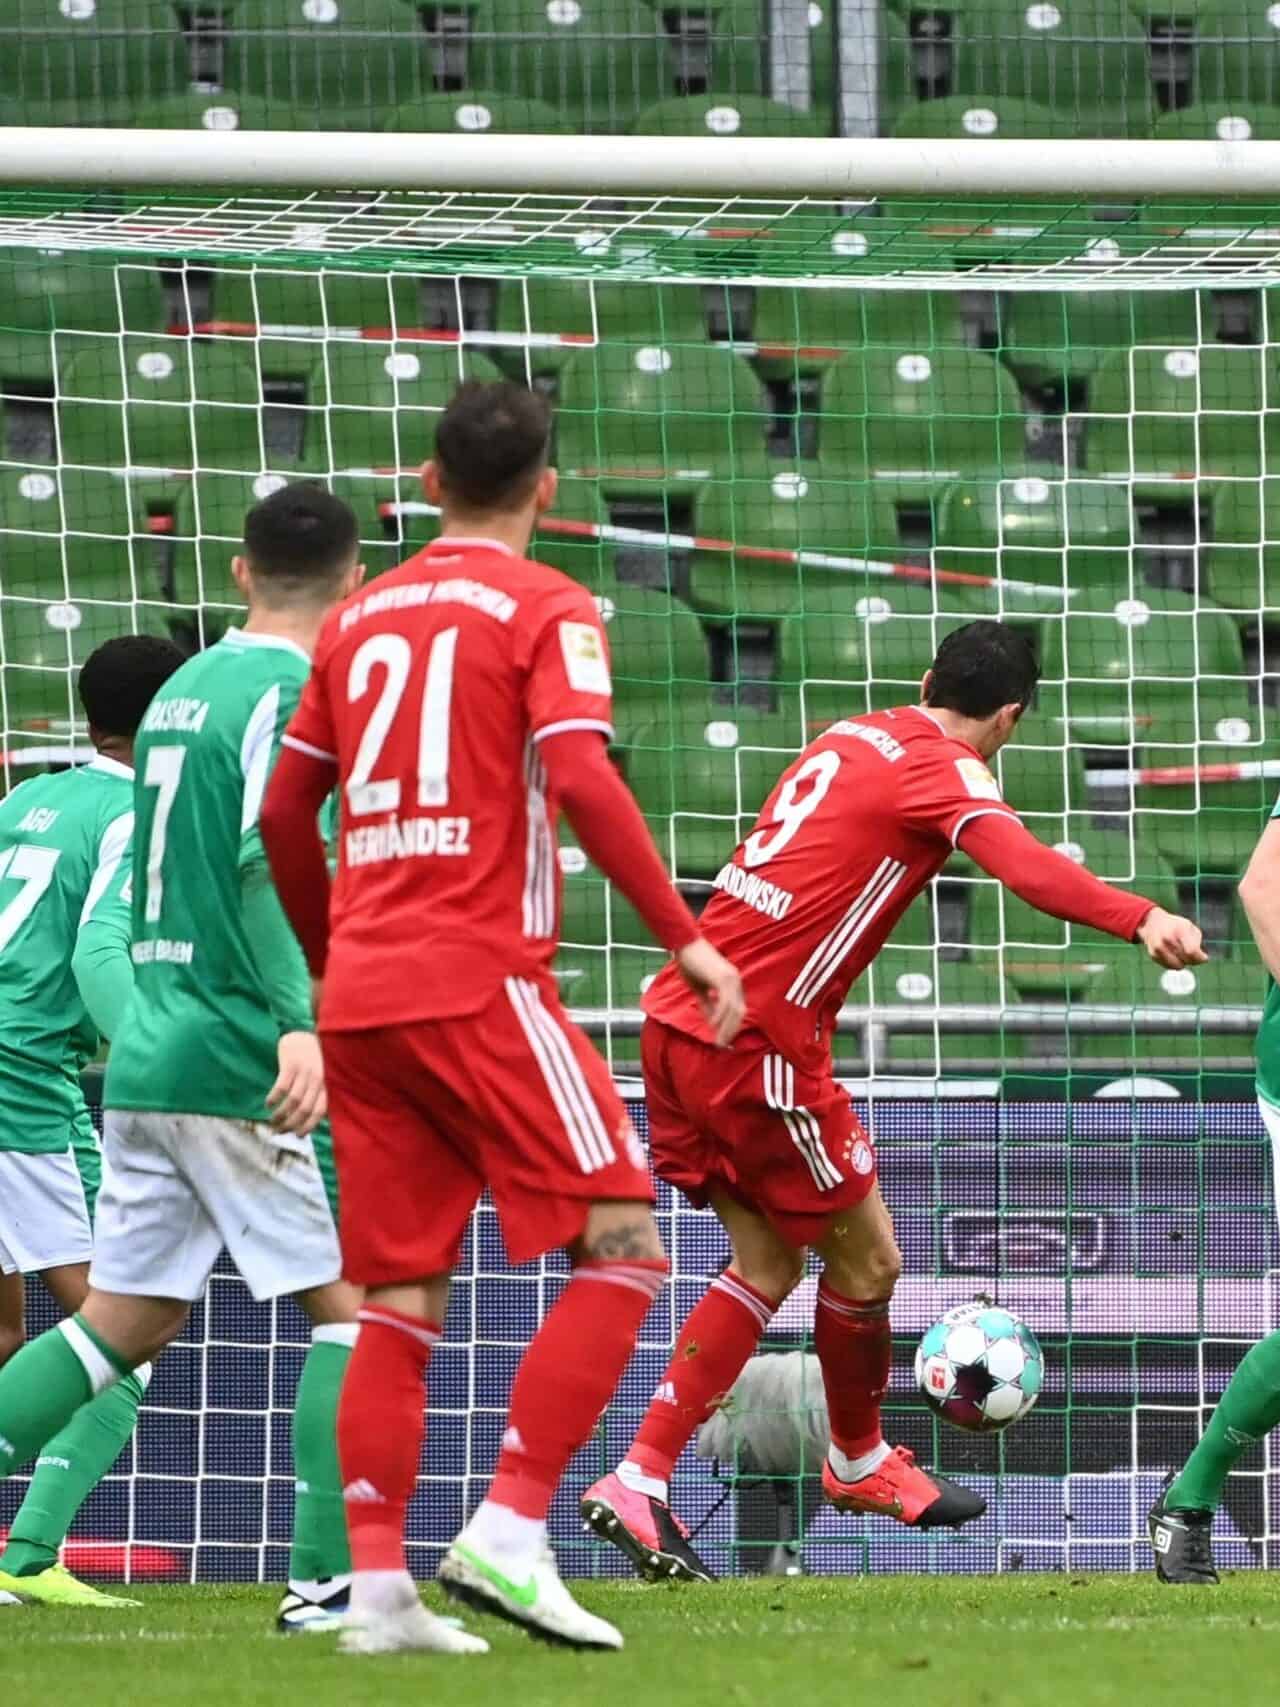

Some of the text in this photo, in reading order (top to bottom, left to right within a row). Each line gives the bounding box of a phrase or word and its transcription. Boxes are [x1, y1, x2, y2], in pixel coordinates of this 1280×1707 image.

[346, 625, 459, 816] 21
[743, 750, 841, 867] 9
[143, 744, 187, 923] 7
